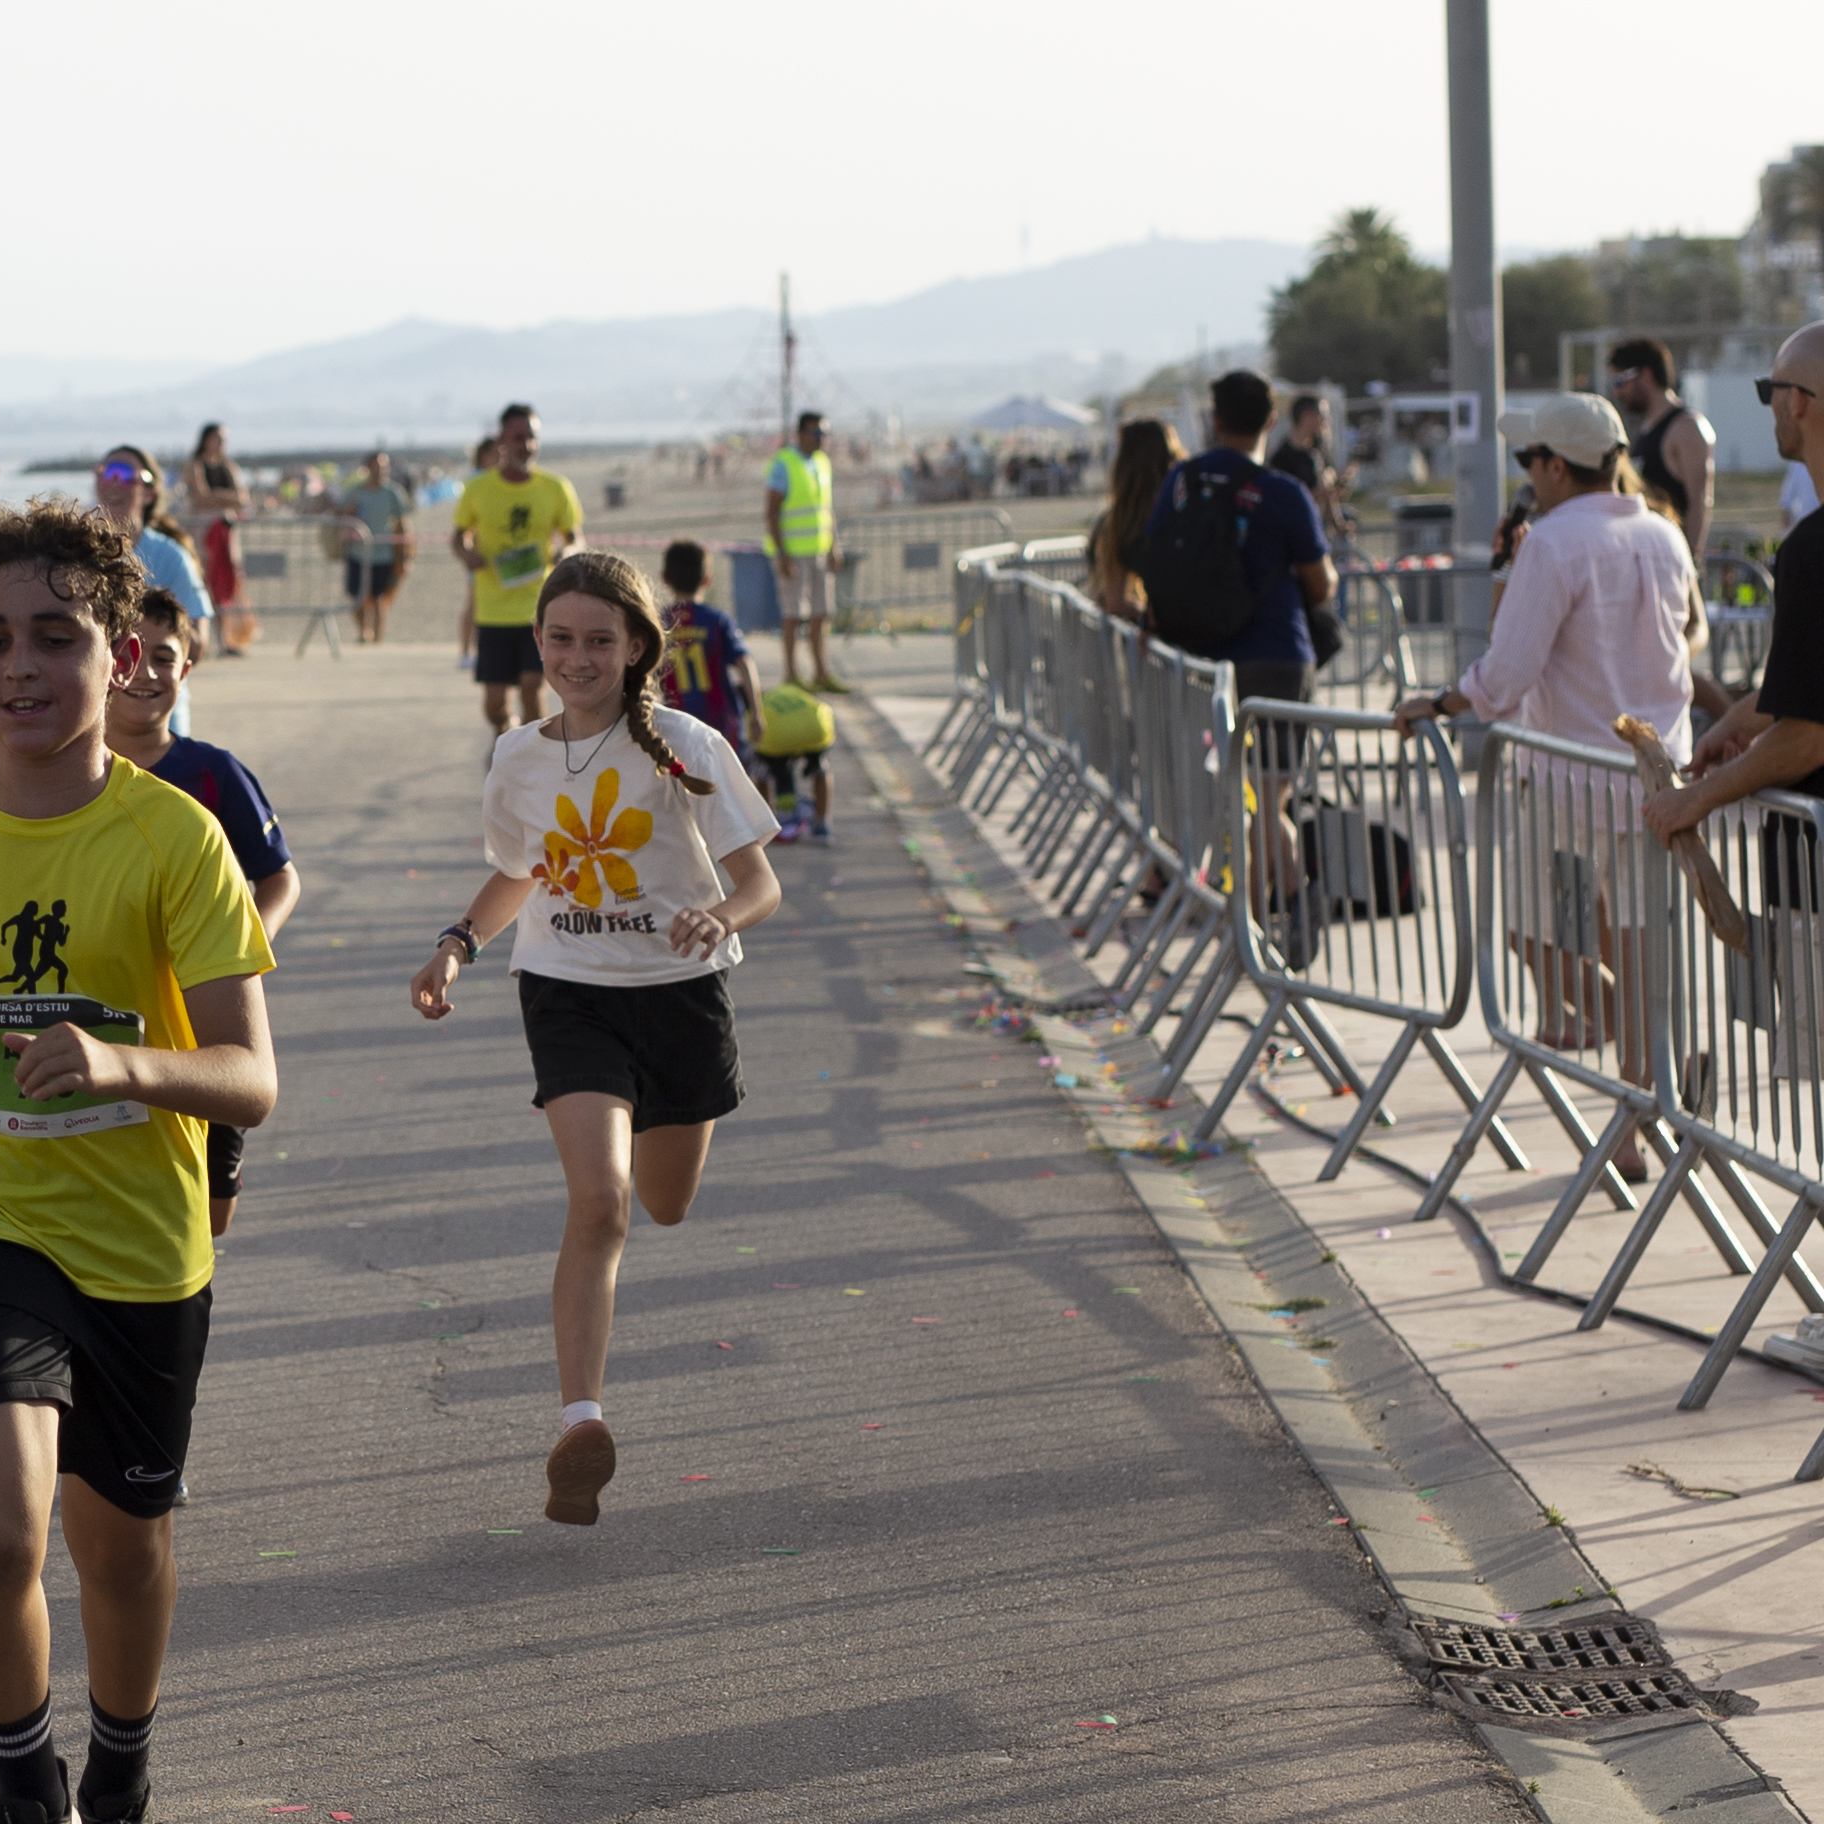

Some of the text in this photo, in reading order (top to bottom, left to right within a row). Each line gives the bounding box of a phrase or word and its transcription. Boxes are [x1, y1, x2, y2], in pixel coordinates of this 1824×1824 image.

[669, 643, 712, 693] 11
[25, 1002, 70, 1012] D'ESTIU
[9, 1015, 33, 1024] MAR
